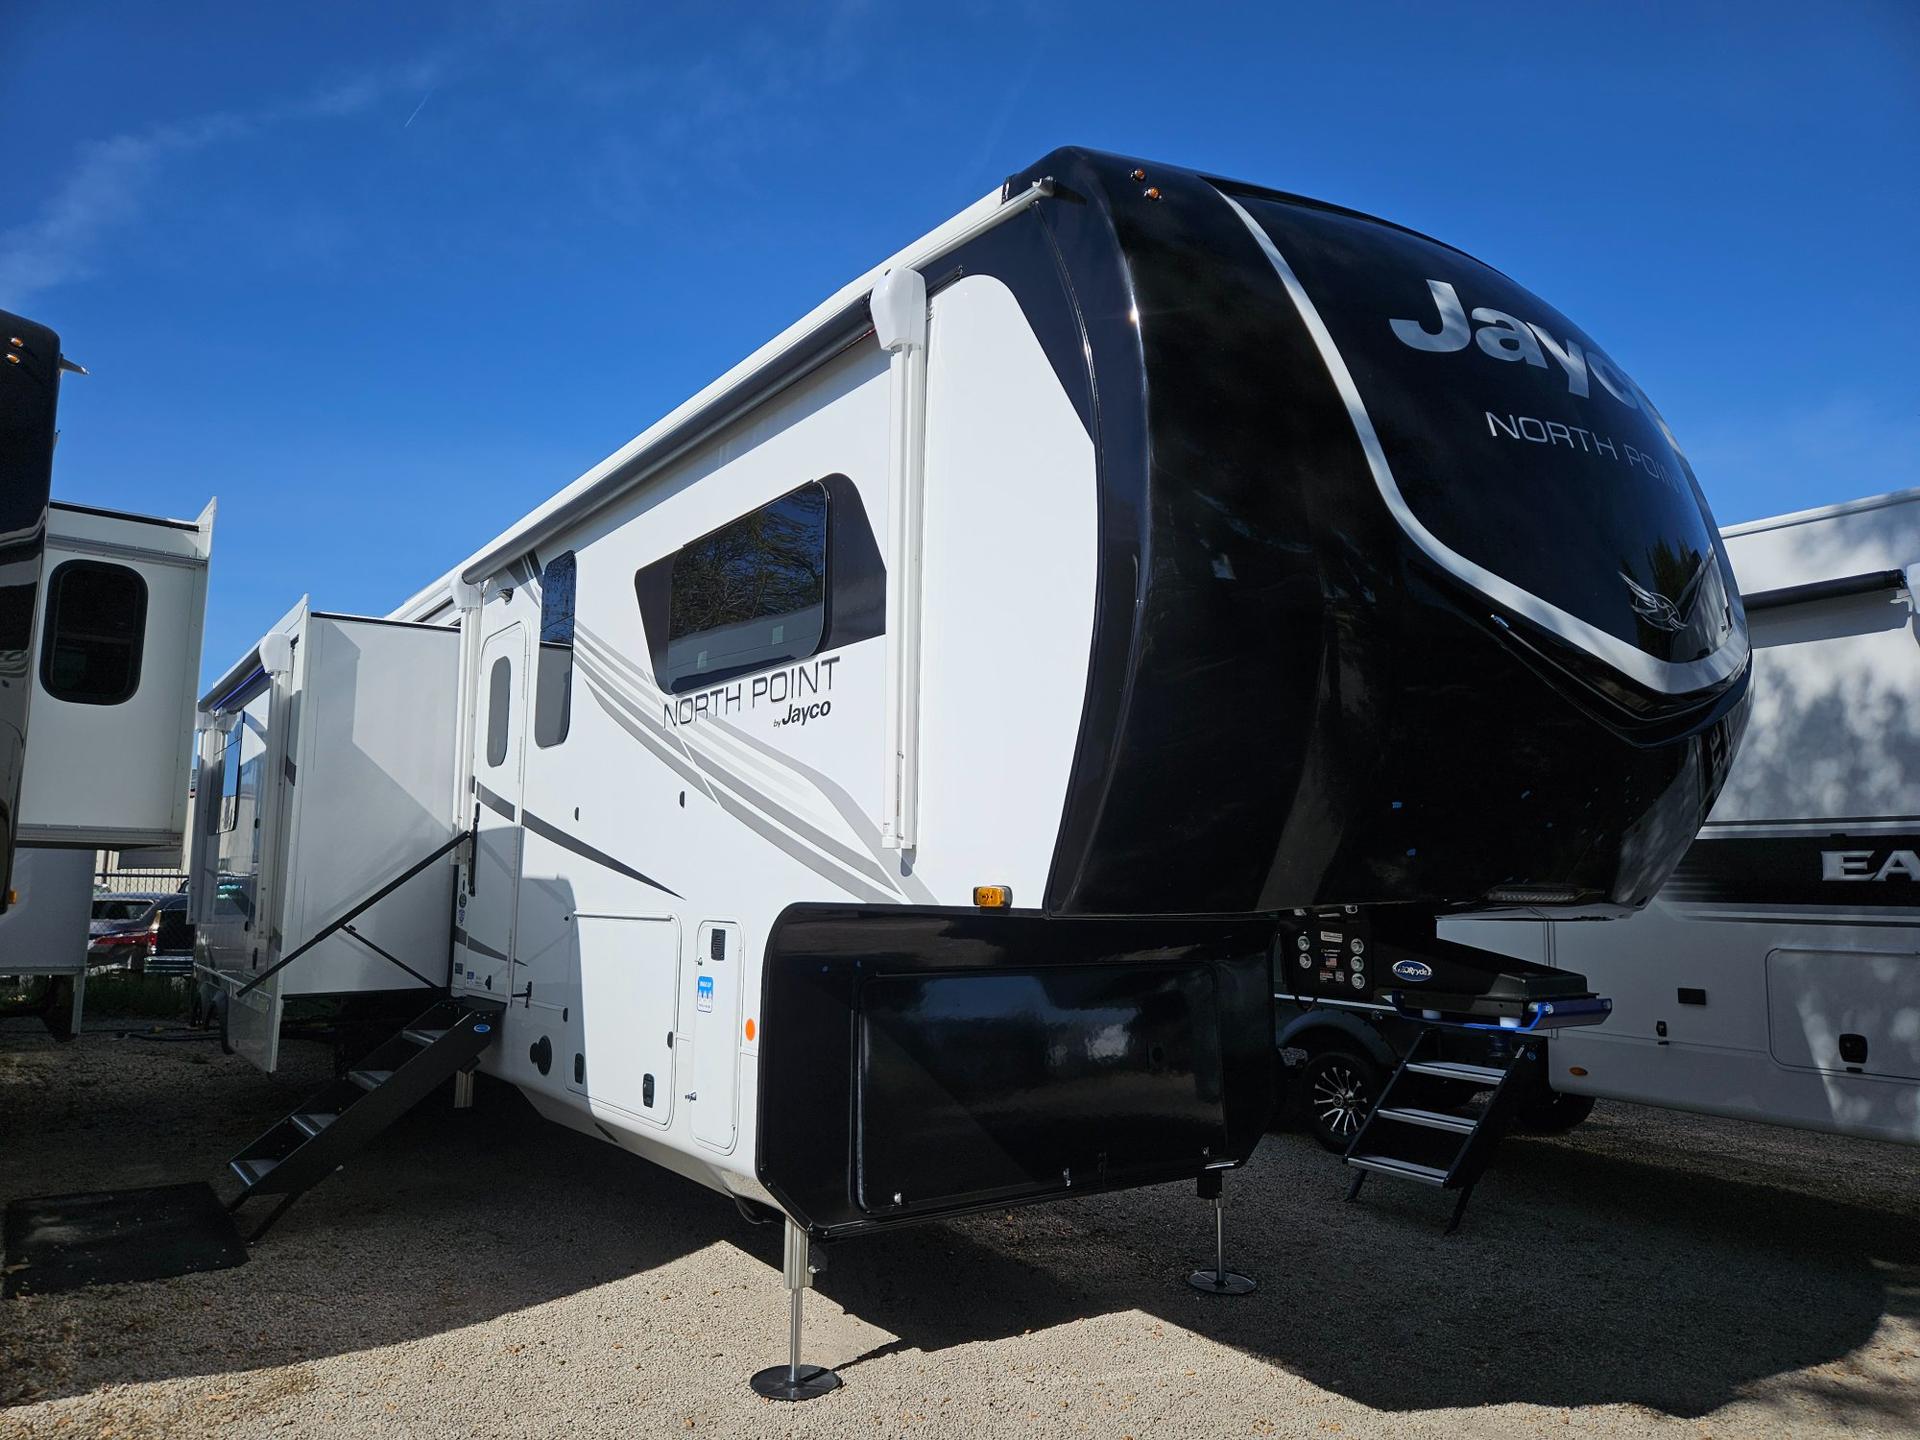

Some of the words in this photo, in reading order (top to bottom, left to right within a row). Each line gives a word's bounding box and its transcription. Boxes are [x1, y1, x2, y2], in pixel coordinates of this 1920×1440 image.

[1389, 279, 1640, 409] Jayc
[1485, 411, 1618, 460] NORTH
[663, 683, 741, 729] NORTH
[752, 656, 840, 708] POINT
[773, 719, 782, 728] by
[782, 700, 831, 726] Jayco
